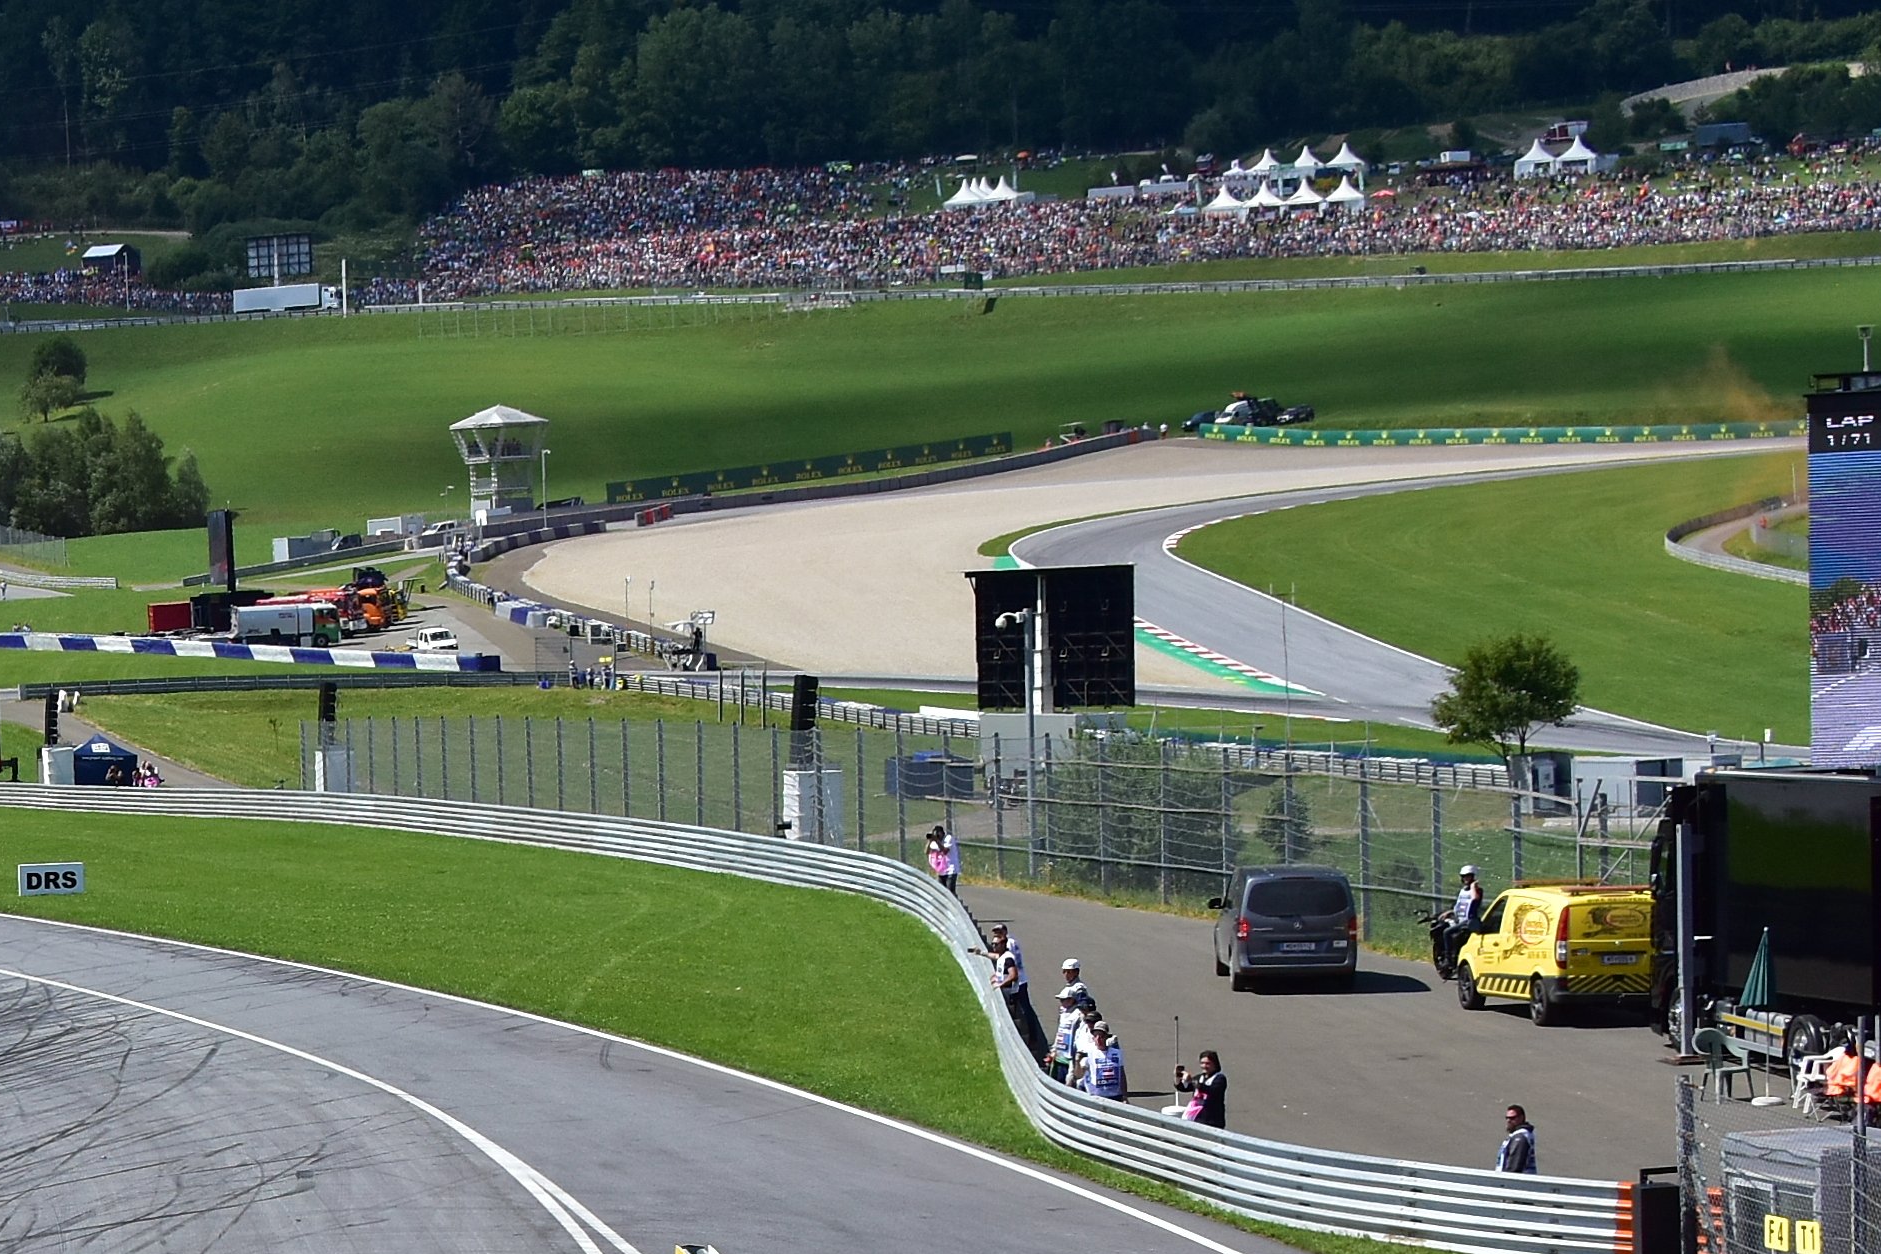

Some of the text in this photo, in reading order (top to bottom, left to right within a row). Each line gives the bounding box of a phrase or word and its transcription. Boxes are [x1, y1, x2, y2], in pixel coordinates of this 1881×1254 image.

[1826, 415, 1874, 428] LAP
[1826, 433, 1870, 446] 1/71
[26, 871, 77, 890] DRS
[1769, 1220, 1783, 1246] F4
[1801, 1225, 1815, 1250] T1
